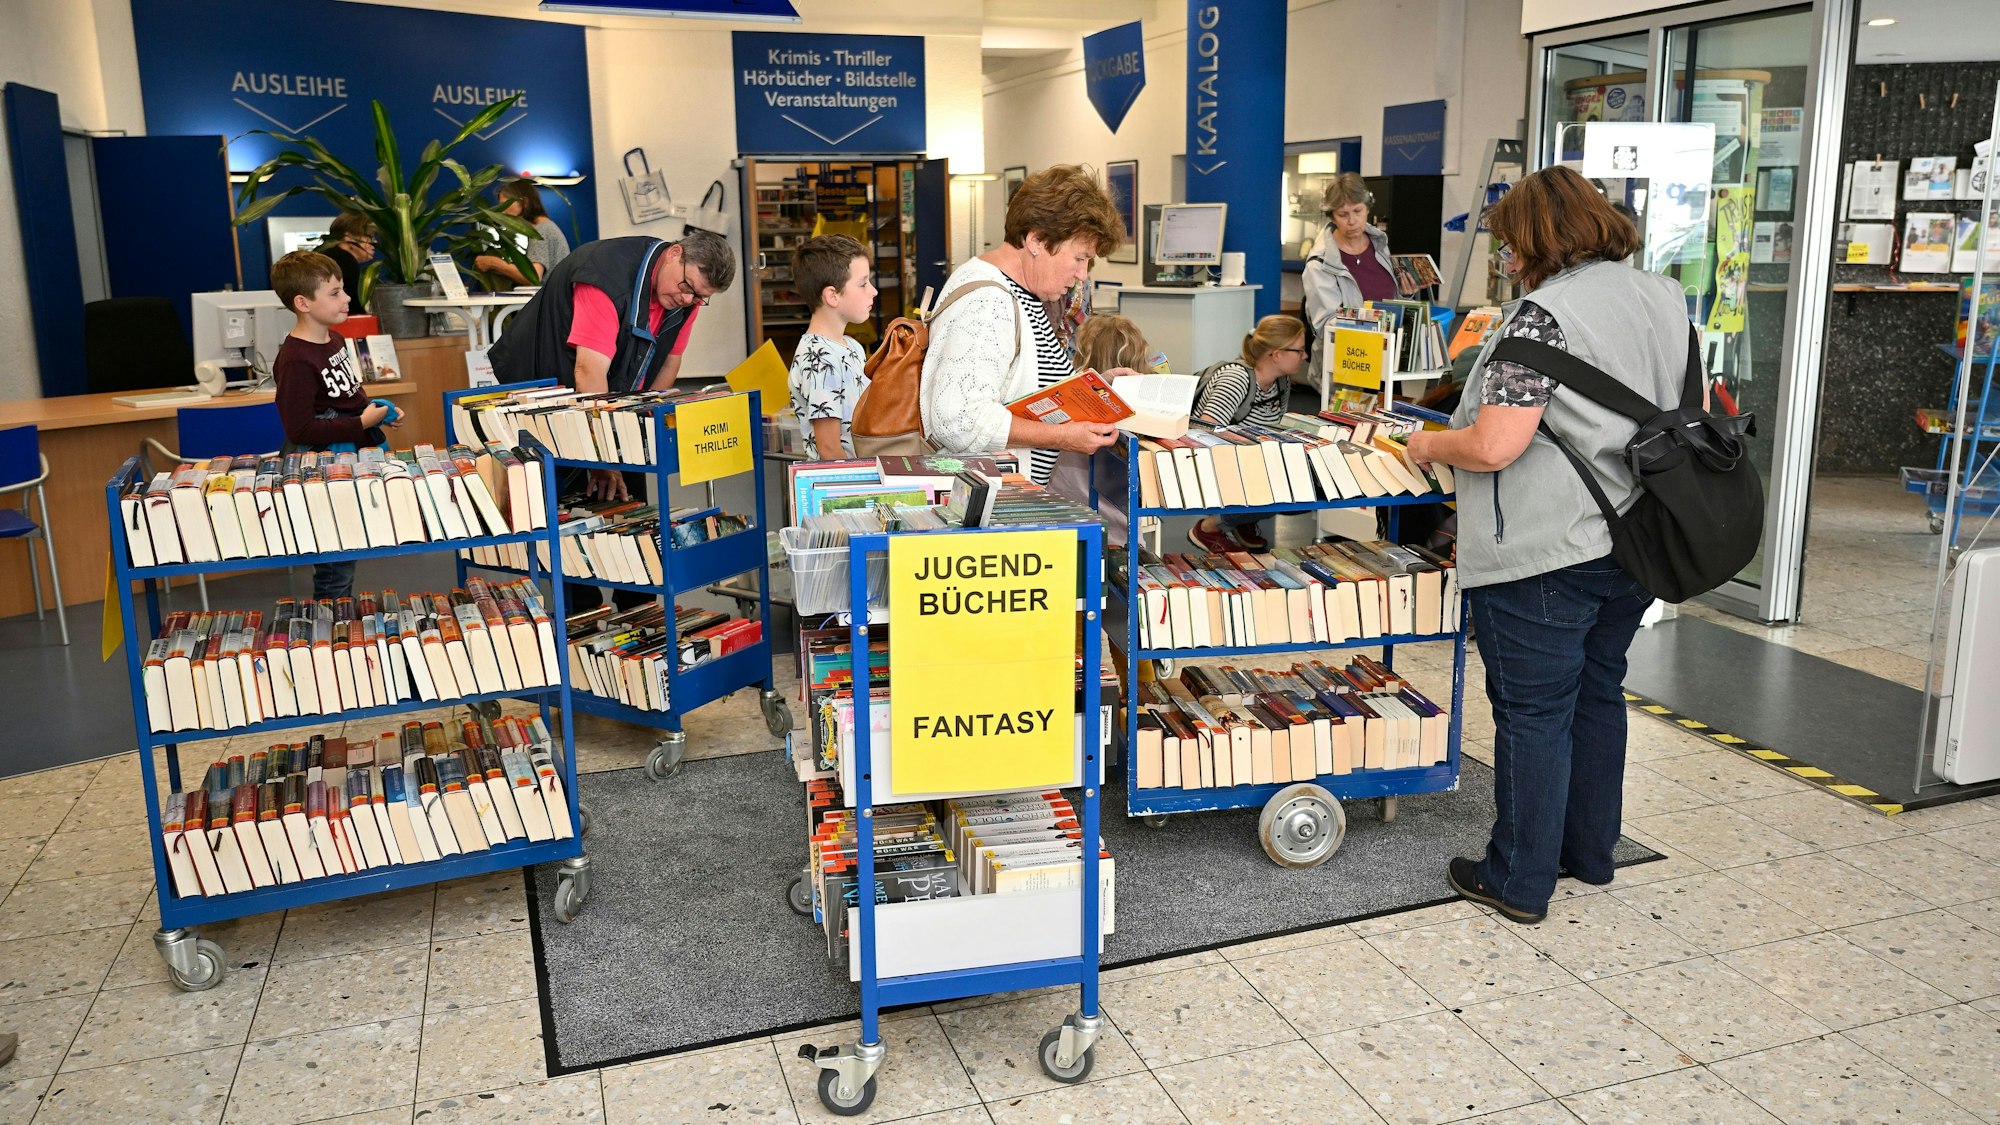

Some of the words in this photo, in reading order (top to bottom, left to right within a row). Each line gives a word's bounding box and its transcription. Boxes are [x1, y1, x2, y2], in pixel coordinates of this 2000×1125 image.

[767, 49, 821, 68] Krimis
[833, 50, 893, 68] Thriller
[231, 71, 348, 99] AUSLEIHE
[743, 68, 832, 88] Hörbücher
[844, 71, 917, 89] Bildstelle
[1197, 6, 1219, 155] KATALOG
[432, 84, 528, 108] AUSLEIHE
[764, 90, 898, 112] Veranstaltungen
[817, 187, 865, 197] Bestseller
[1346, 347, 1368, 358] SACH-
[1342, 359, 1371, 373] BÜCHER
[703, 422, 729, 437] KRIMI
[694, 437, 739, 455] THRILLER
[914, 553, 1054, 581] JUGEND-
[919, 586, 1050, 616] BÜCHER
[913, 709, 1055, 739] FANTASY
